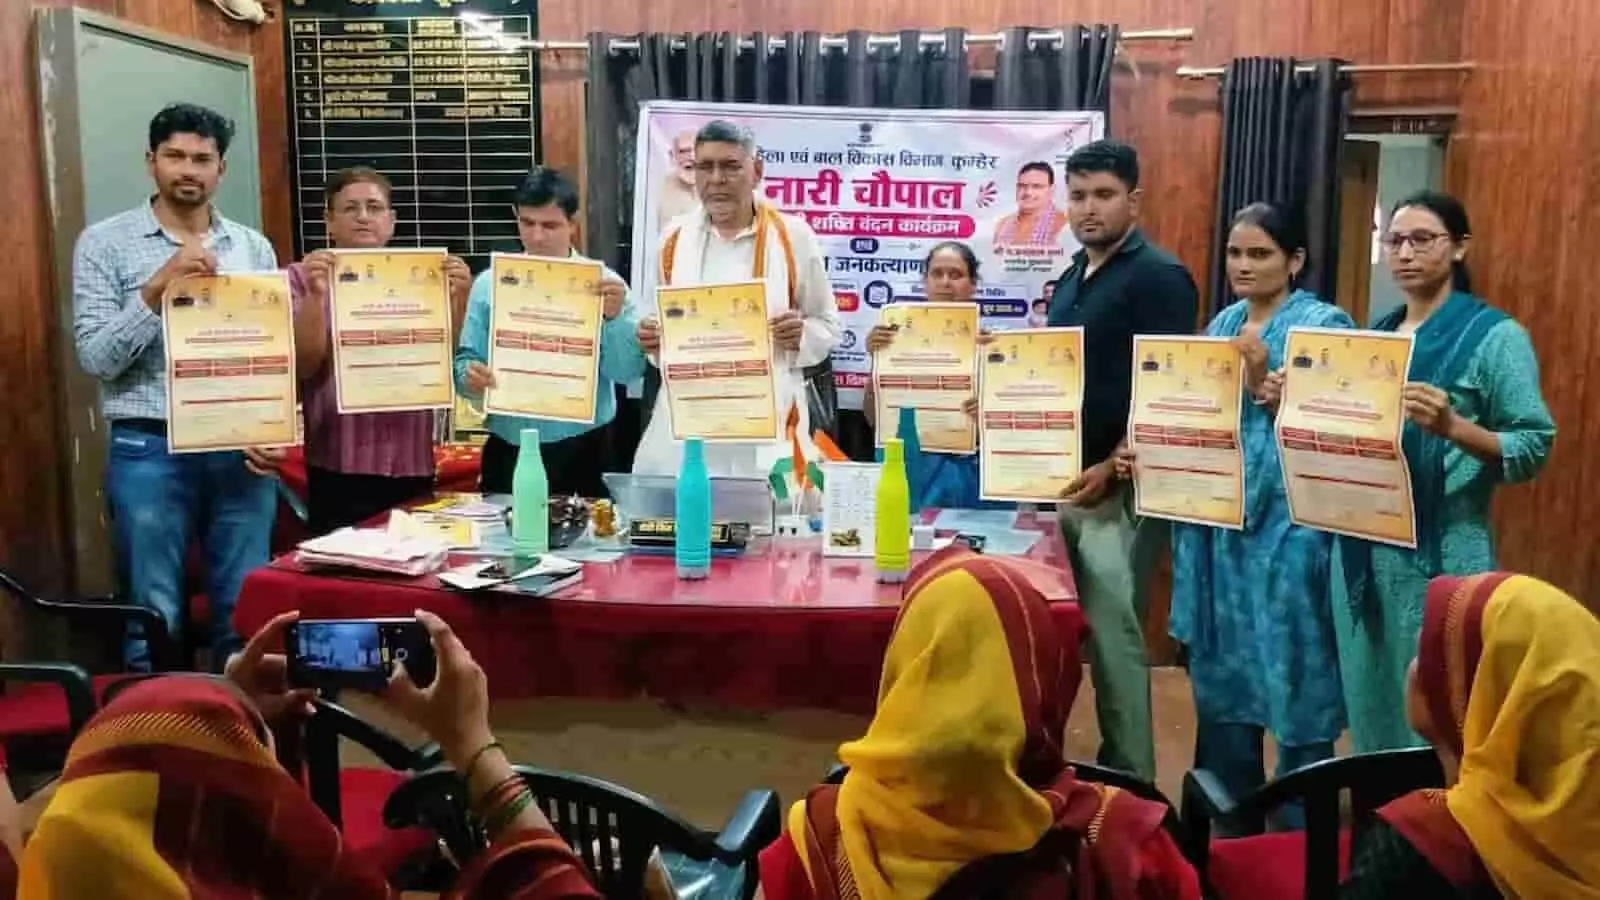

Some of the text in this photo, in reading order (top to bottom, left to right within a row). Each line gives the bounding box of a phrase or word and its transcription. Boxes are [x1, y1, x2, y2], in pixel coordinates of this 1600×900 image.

[790, 147, 809, 164] एवं
[813, 151, 843, 165] बाल
[847, 149, 895, 167] विकास
[899, 149, 945, 167] विभाग
[764, 169, 967, 209] नारी चौपाल
[811, 213, 855, 233] शक्ति
[859, 216, 893, 234] वंदन
[899, 216, 961, 237] कार्यक्रम
[834, 256, 925, 274] जनकल्याण
